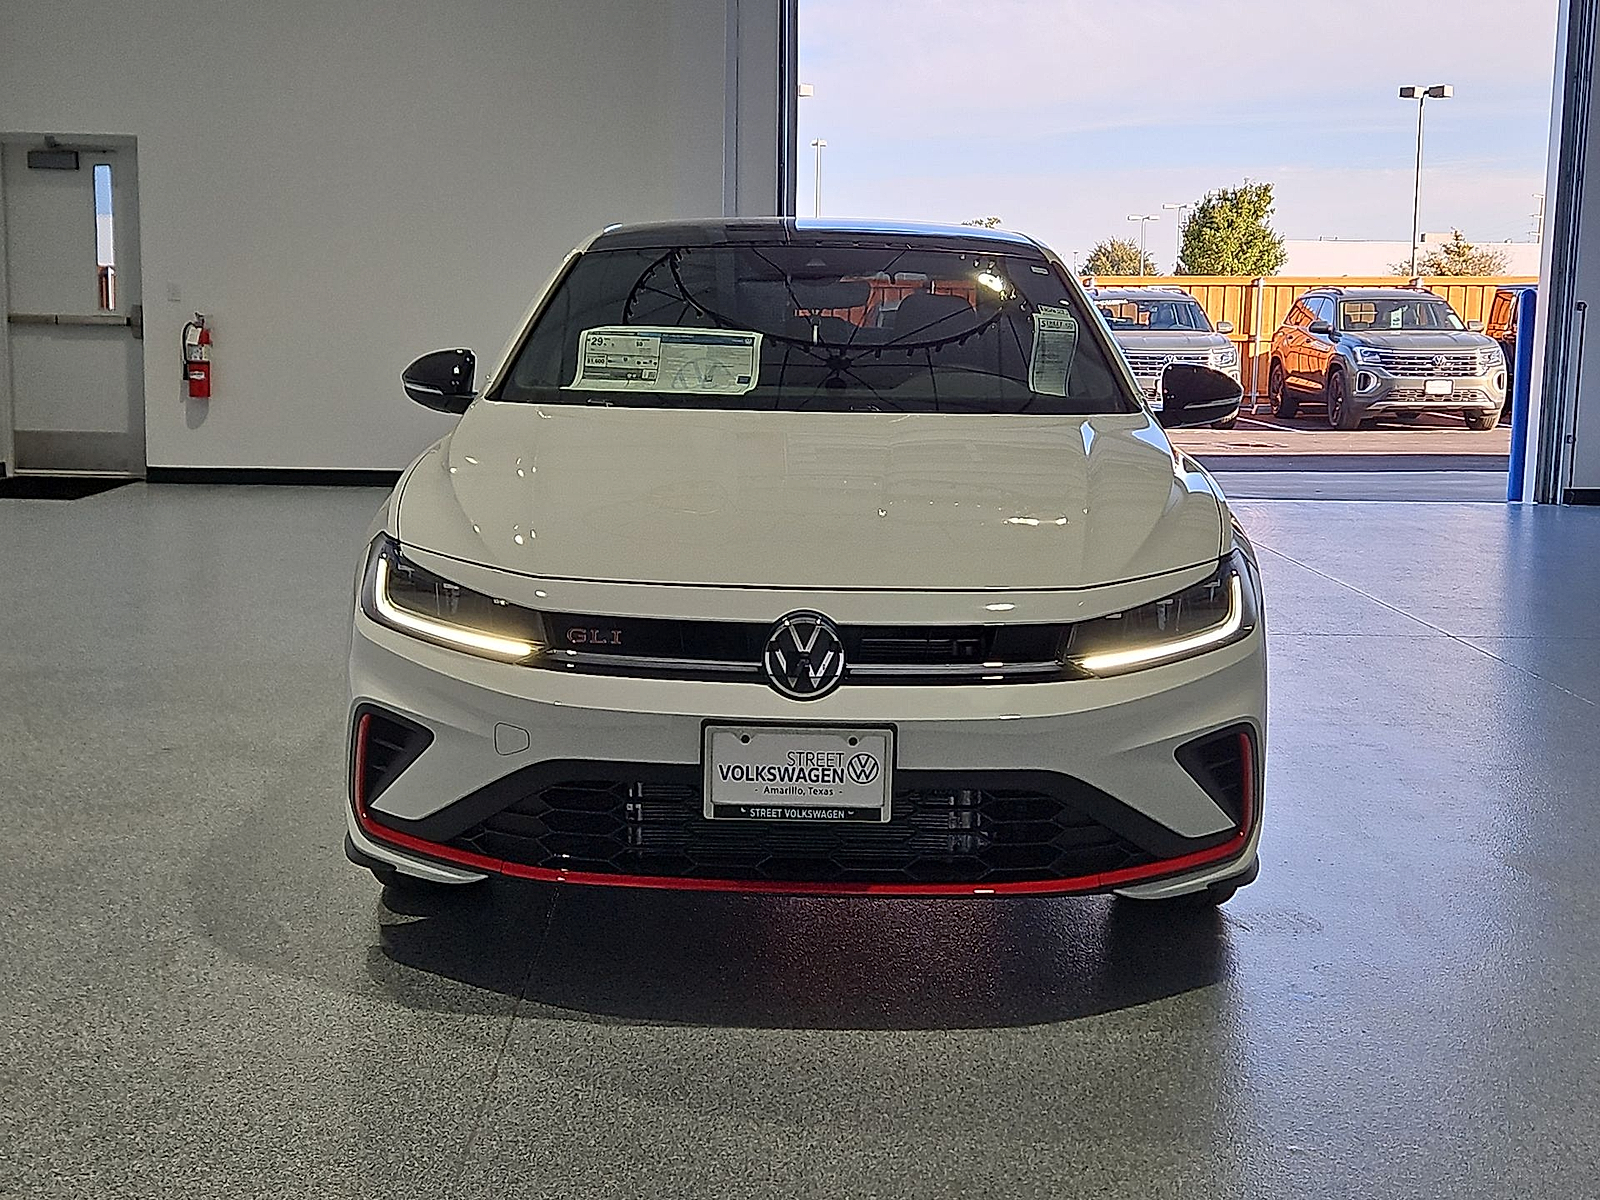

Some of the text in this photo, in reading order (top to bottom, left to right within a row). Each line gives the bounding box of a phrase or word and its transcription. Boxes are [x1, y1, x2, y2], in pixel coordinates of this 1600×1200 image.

[591, 336, 604, 346] 29
[566, 628, 622, 645] GLI
[765, 609, 845, 700] VW
[786, 751, 845, 768] STREET
[718, 764, 845, 784] VOLKSWAGEN
[847, 753, 880, 784] VW
[763, 785, 834, 796] Amarillo, Texas
[750, 808, 845, 819] STREET VOLKSWAGEN
